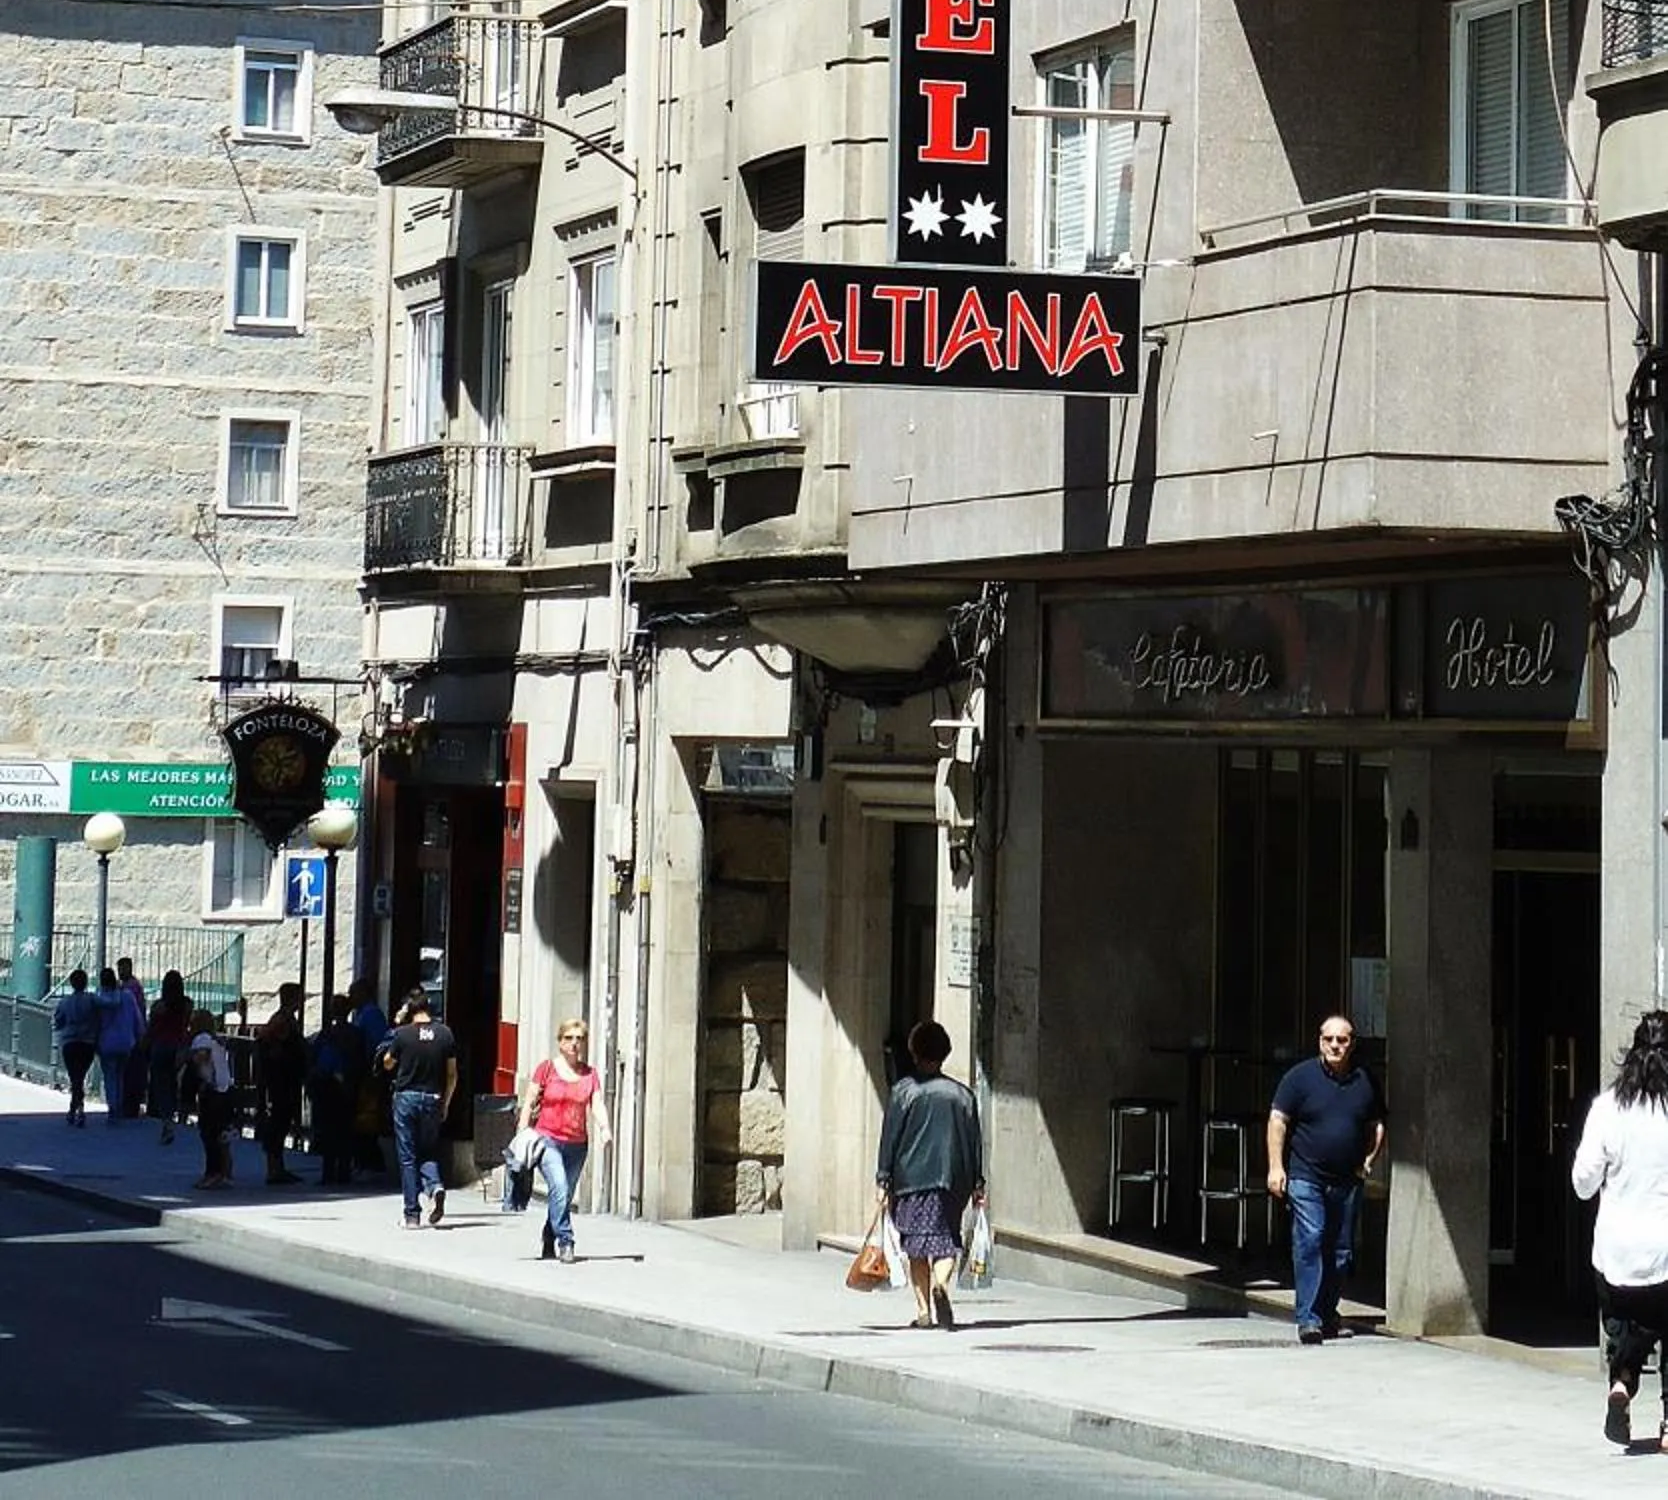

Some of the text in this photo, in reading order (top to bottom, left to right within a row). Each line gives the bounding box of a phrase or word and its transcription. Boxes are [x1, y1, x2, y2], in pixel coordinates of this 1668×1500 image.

[774, 278, 1123, 377] ALTIANA
[1446, 617, 1554, 690] Hotel
[91, 769, 120, 783] LAS
[127, 769, 199, 784] MEJORES
